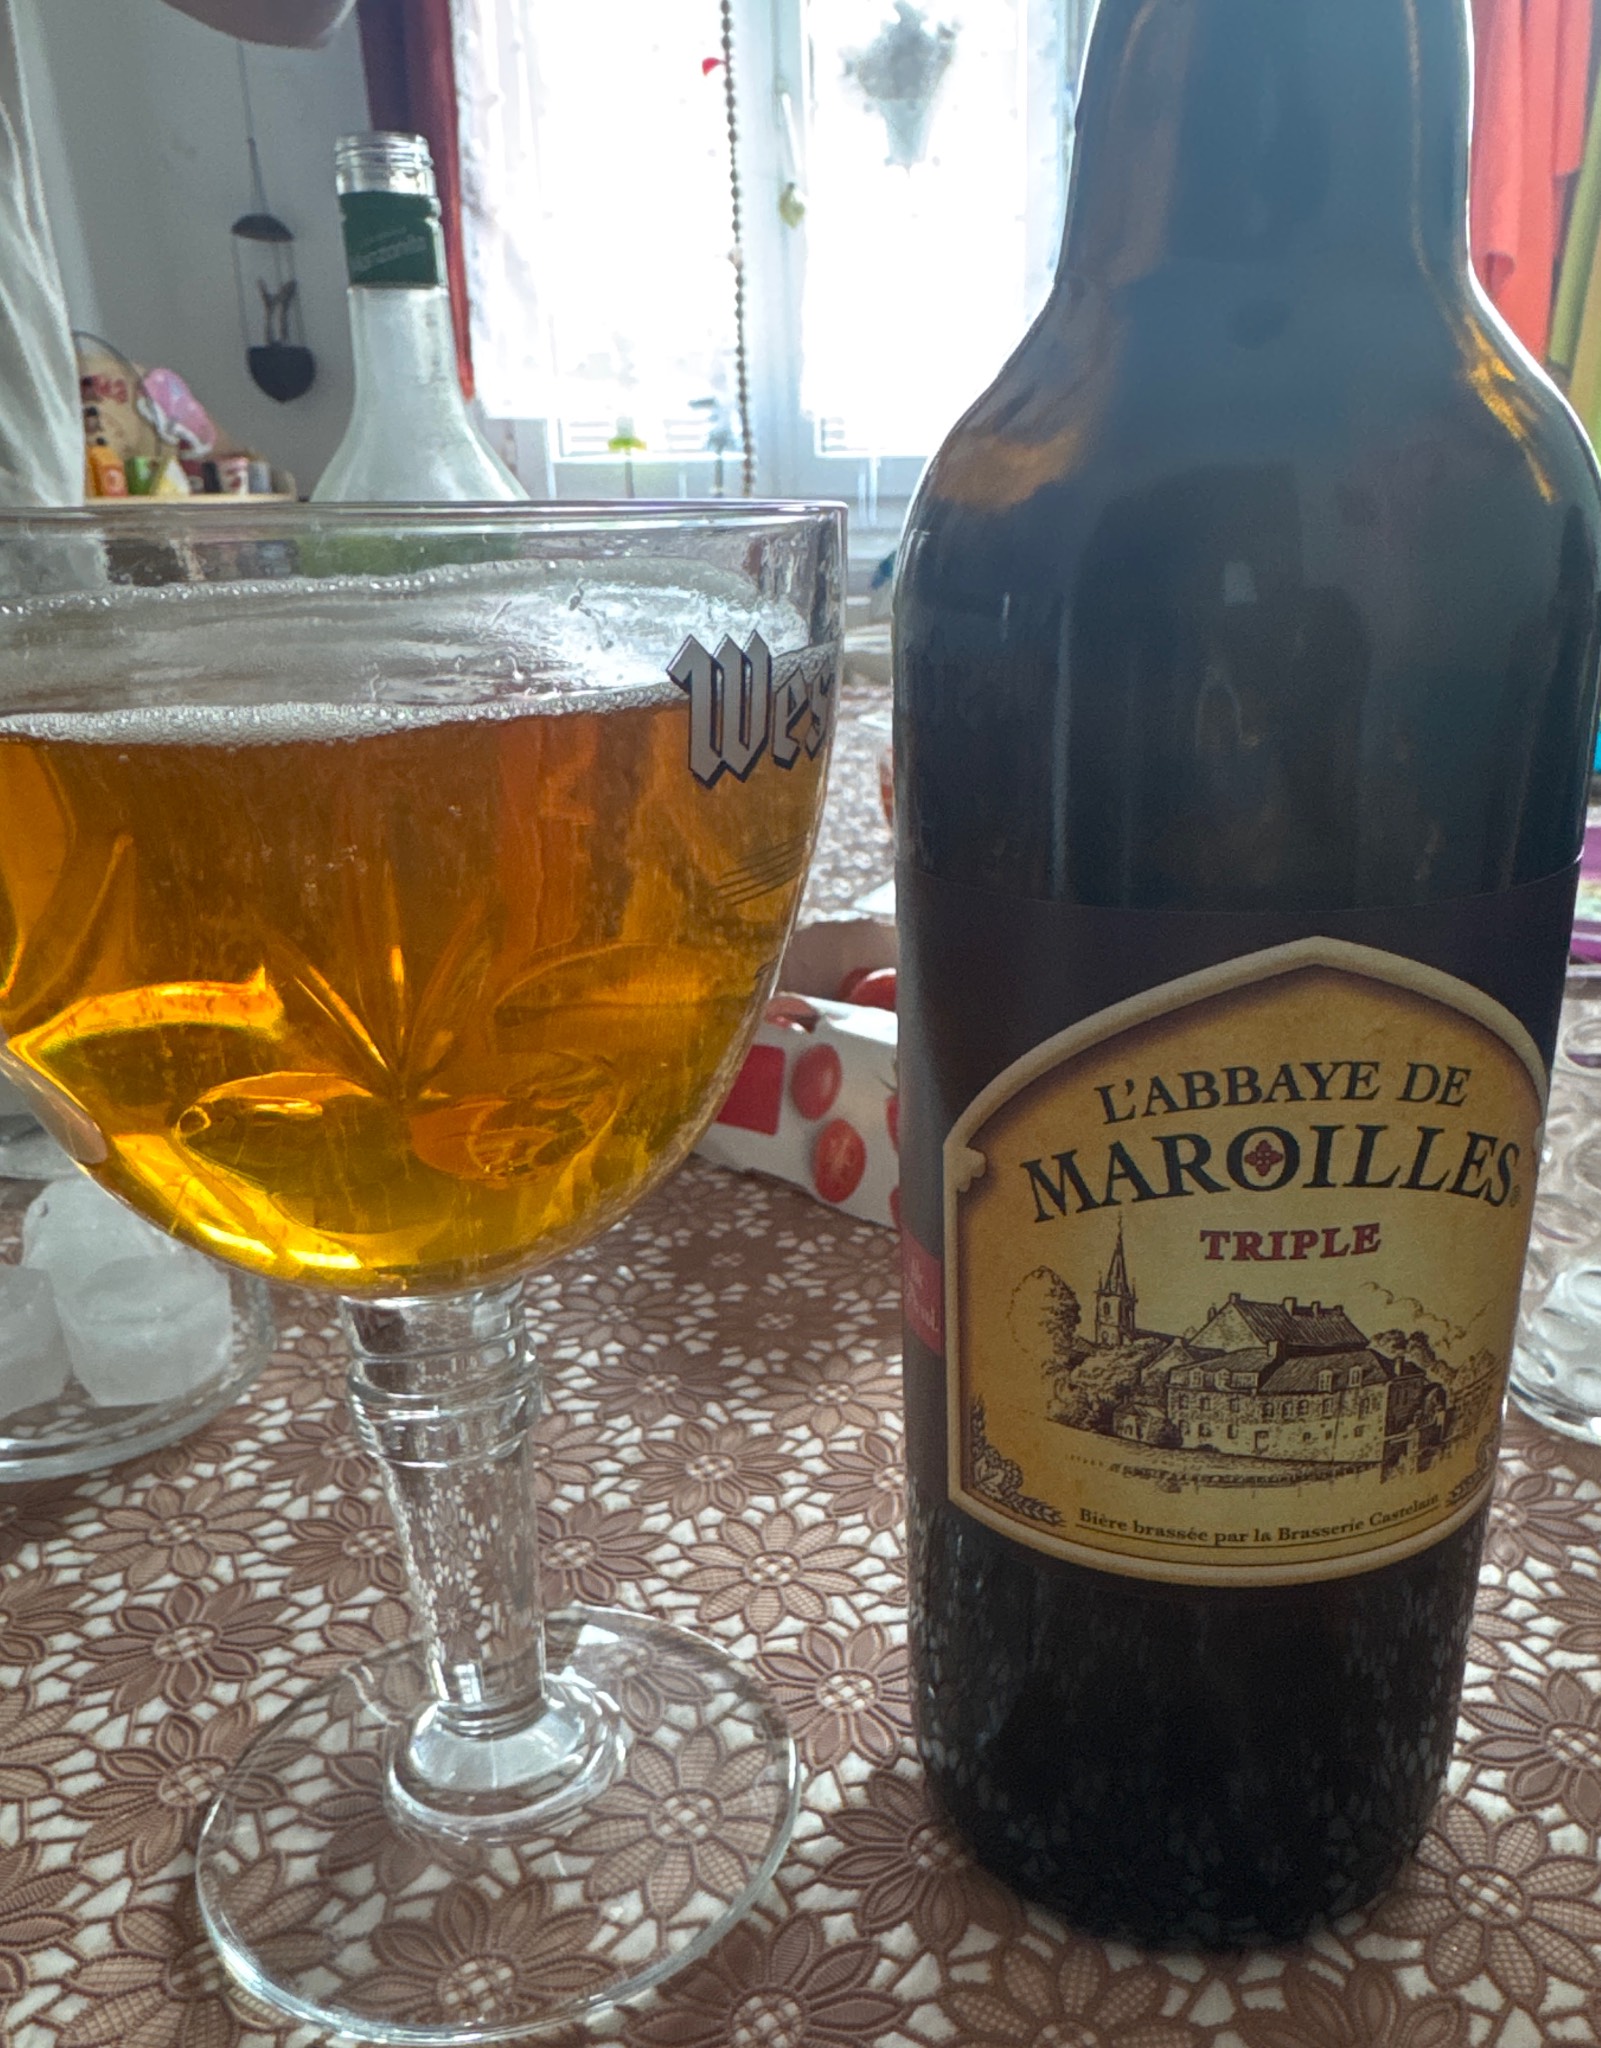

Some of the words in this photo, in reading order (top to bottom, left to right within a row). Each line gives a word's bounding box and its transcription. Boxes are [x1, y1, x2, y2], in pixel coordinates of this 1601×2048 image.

[1094, 1061, 1382, 1125] L'ABBAYE
[1397, 1062, 1472, 1107] DE
[1020, 1124, 1521, 1223] MAROILLES
[1200, 1222, 1382, 1261] TRIPLE
[1079, 1508, 1128, 1532] Bière
[1133, 1519, 1209, 1541] brassée
[1215, 1531, 1249, 1546] par
[1253, 1528, 1272, 1542] la
[1278, 1519, 1365, 1541] Brasserie
[1369, 1493, 1440, 1526] Castelain
